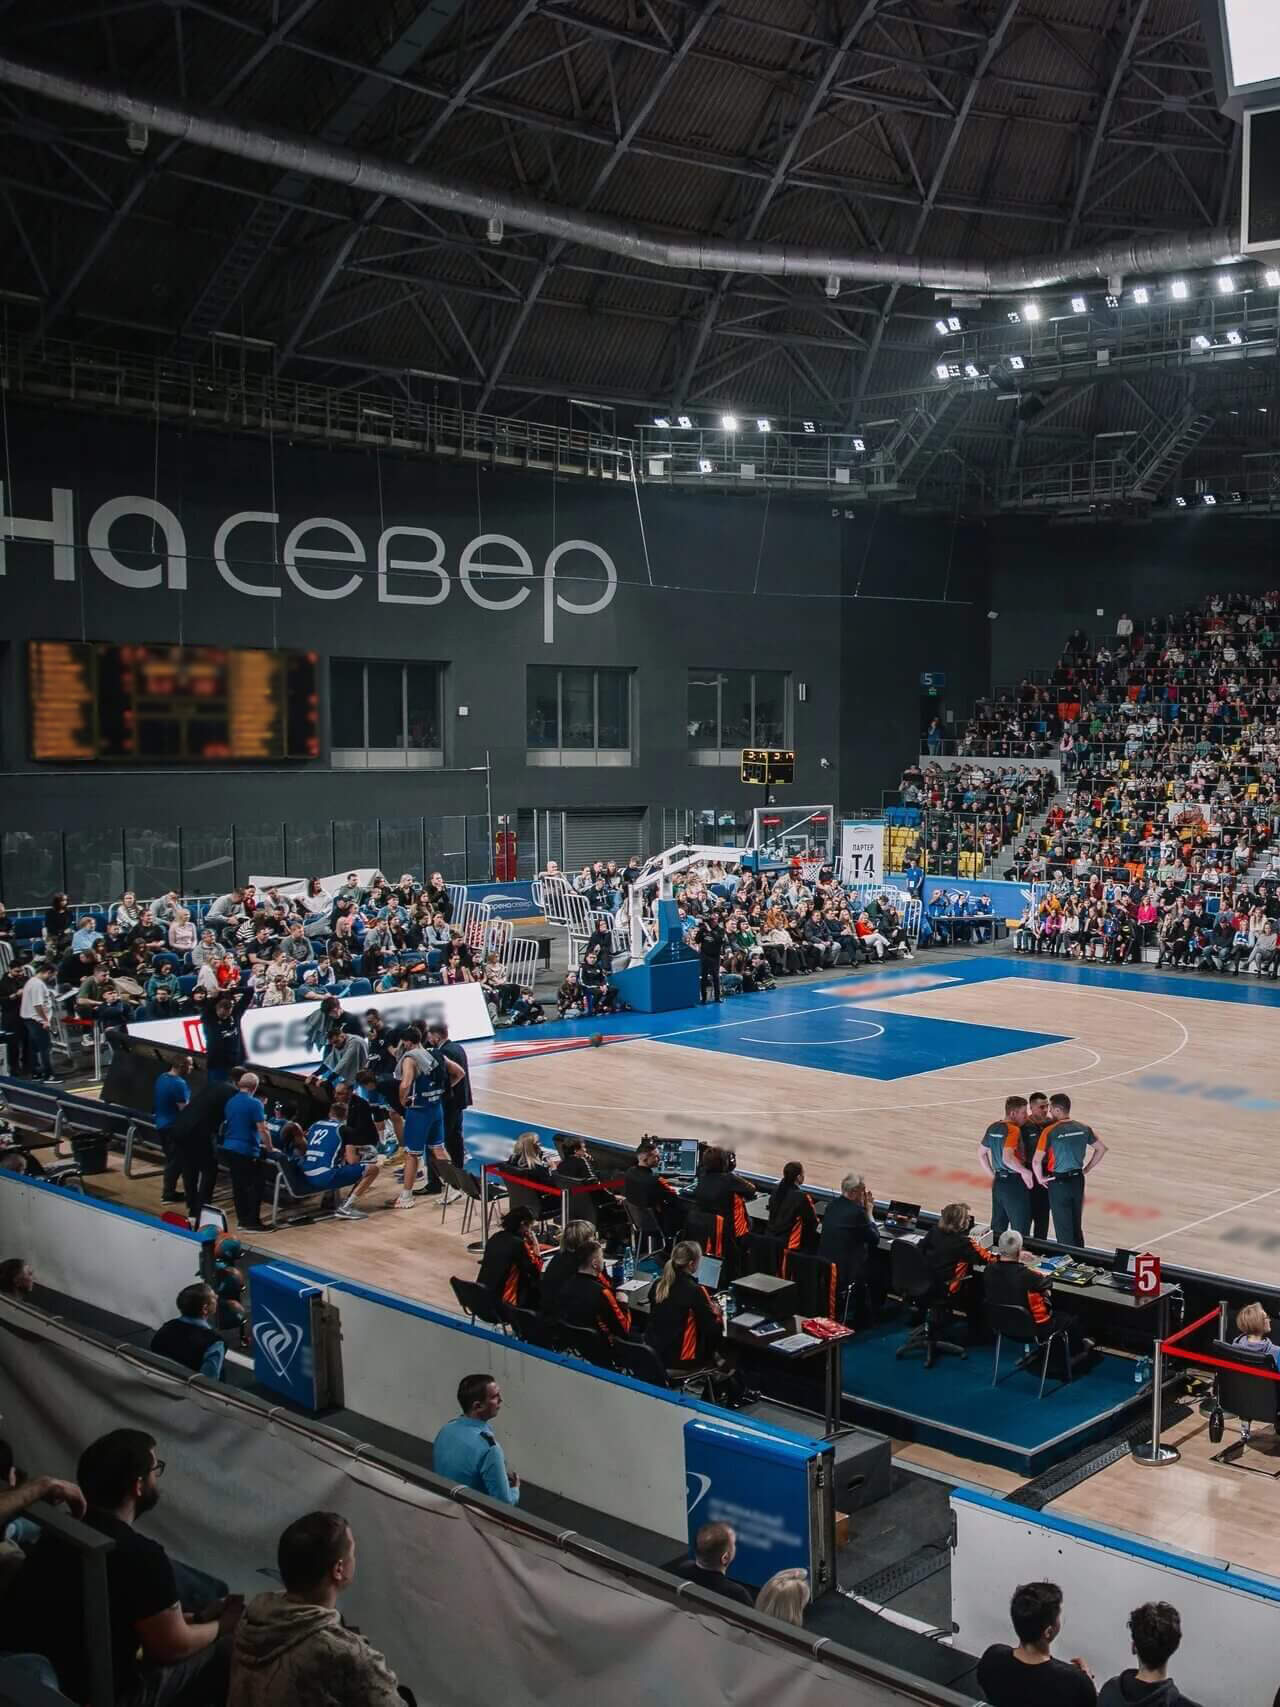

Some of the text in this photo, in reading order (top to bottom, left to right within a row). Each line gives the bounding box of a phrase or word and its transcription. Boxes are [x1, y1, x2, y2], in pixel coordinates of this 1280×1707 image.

[214, 511, 617, 643] север
[310, 1129, 328, 1146] 12
[1138, 1259, 1157, 1291] 5
